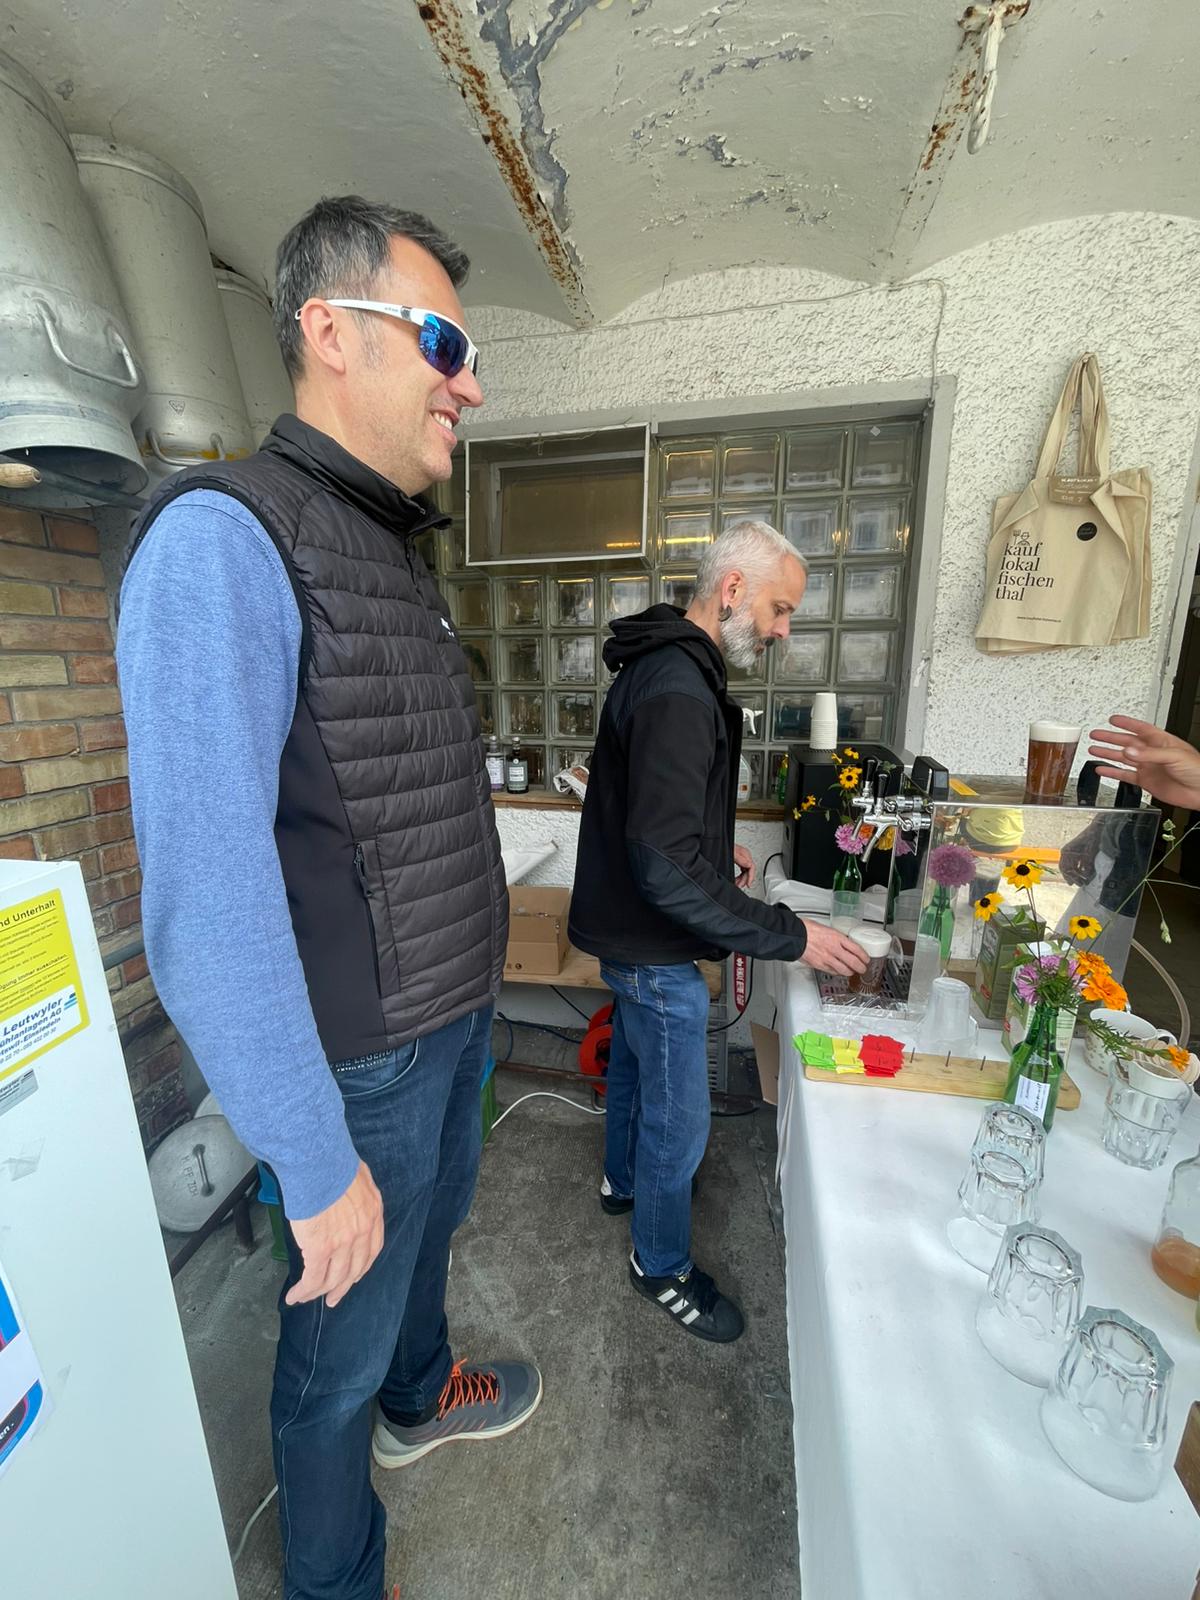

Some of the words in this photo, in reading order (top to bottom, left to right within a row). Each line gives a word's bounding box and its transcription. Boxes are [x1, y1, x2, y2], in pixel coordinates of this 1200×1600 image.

[1004, 542, 1043, 556] kauf
[1000, 556, 1040, 571] lokal
[998, 571, 1054, 588] fischen
[995, 586, 1025, 601] thal
[12, 900, 56, 922] Unterhalt
[3, 998, 63, 1036] Leutwyler
[49, 1007, 62, 1020] AG
